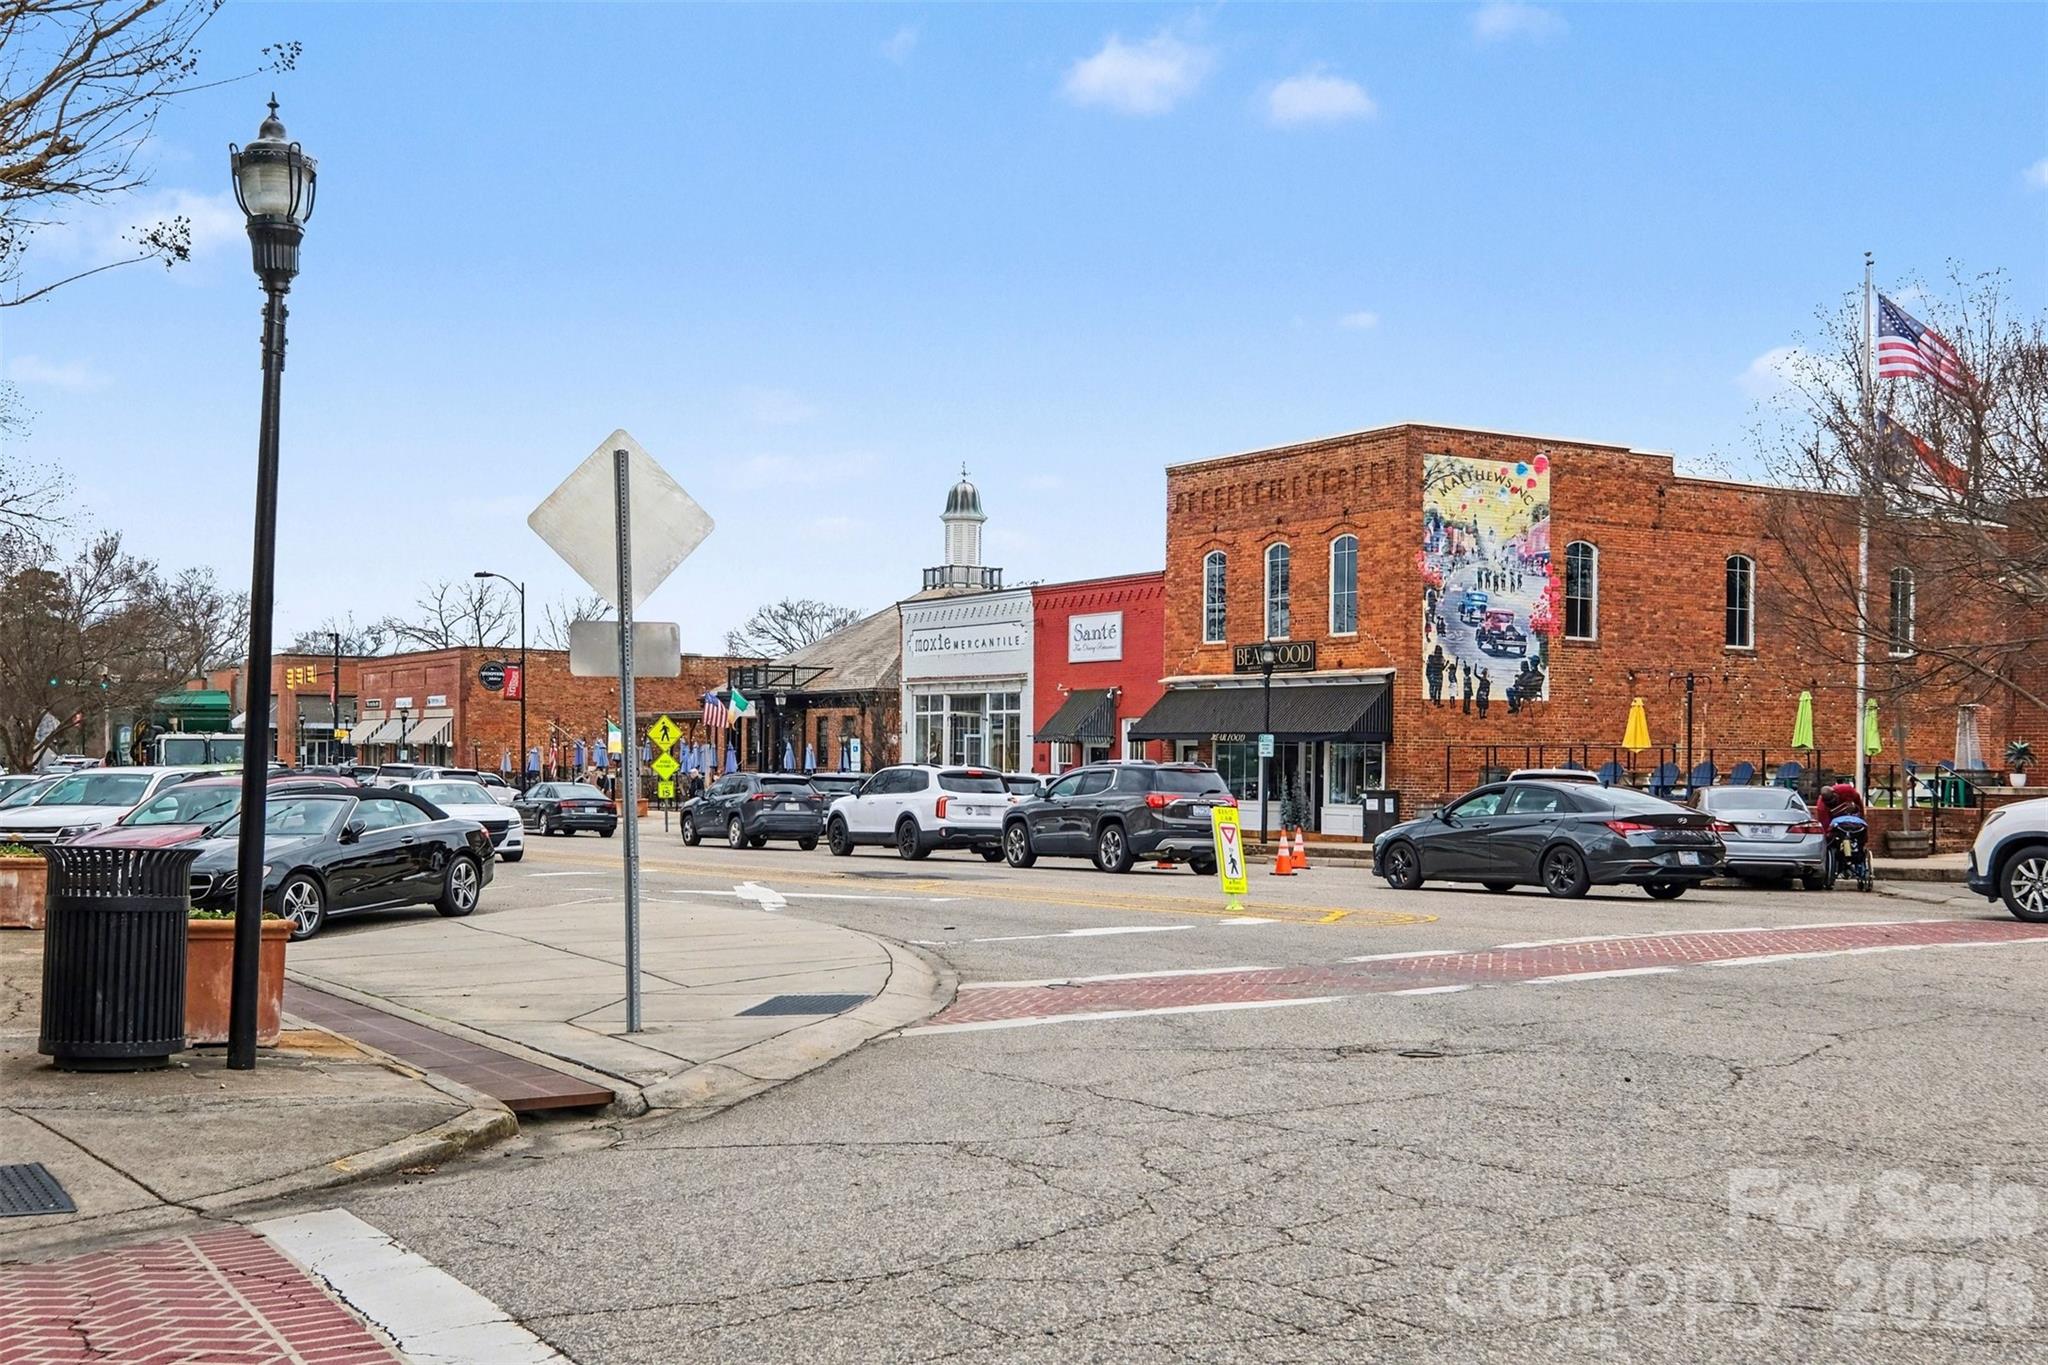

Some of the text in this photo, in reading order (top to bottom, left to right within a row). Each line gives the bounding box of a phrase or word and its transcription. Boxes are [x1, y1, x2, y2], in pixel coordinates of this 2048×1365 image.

[1516, 486, 1535, 506] NC
[1073, 620, 1117, 642] Santé
[914, 633, 1020, 653] moxie MERCANTILE
[1236, 647, 1264, 666] BEA
